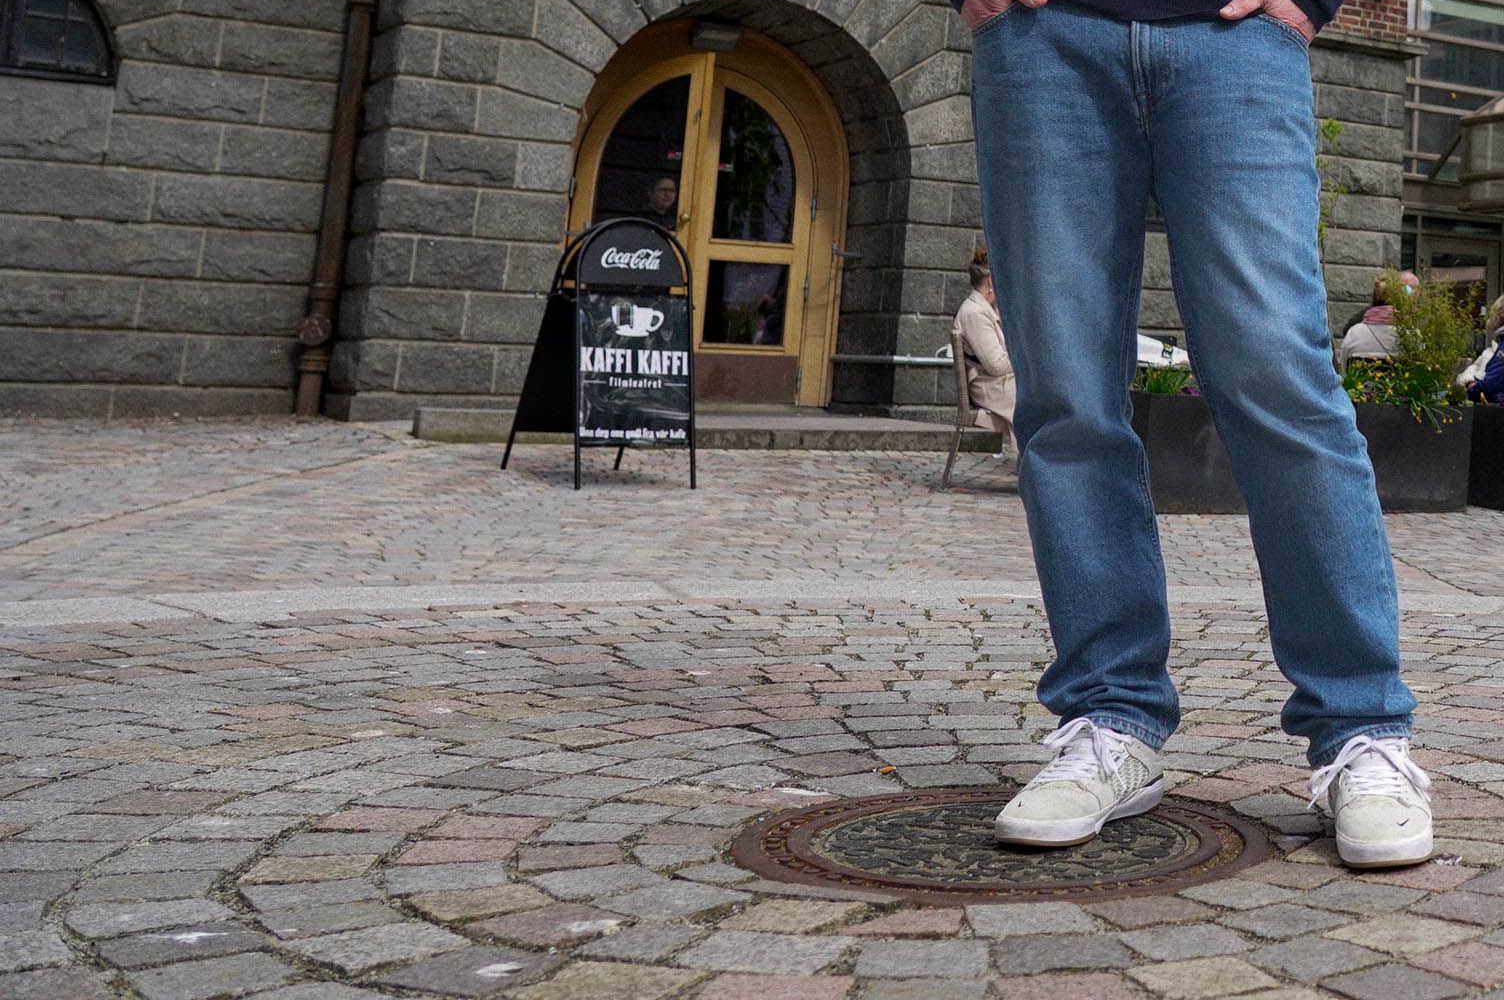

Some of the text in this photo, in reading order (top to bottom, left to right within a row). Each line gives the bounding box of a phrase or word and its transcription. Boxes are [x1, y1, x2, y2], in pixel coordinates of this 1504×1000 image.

[601, 247, 664, 270] Coca-Cola
[580, 346, 689, 376] KAFFI KAFFI
